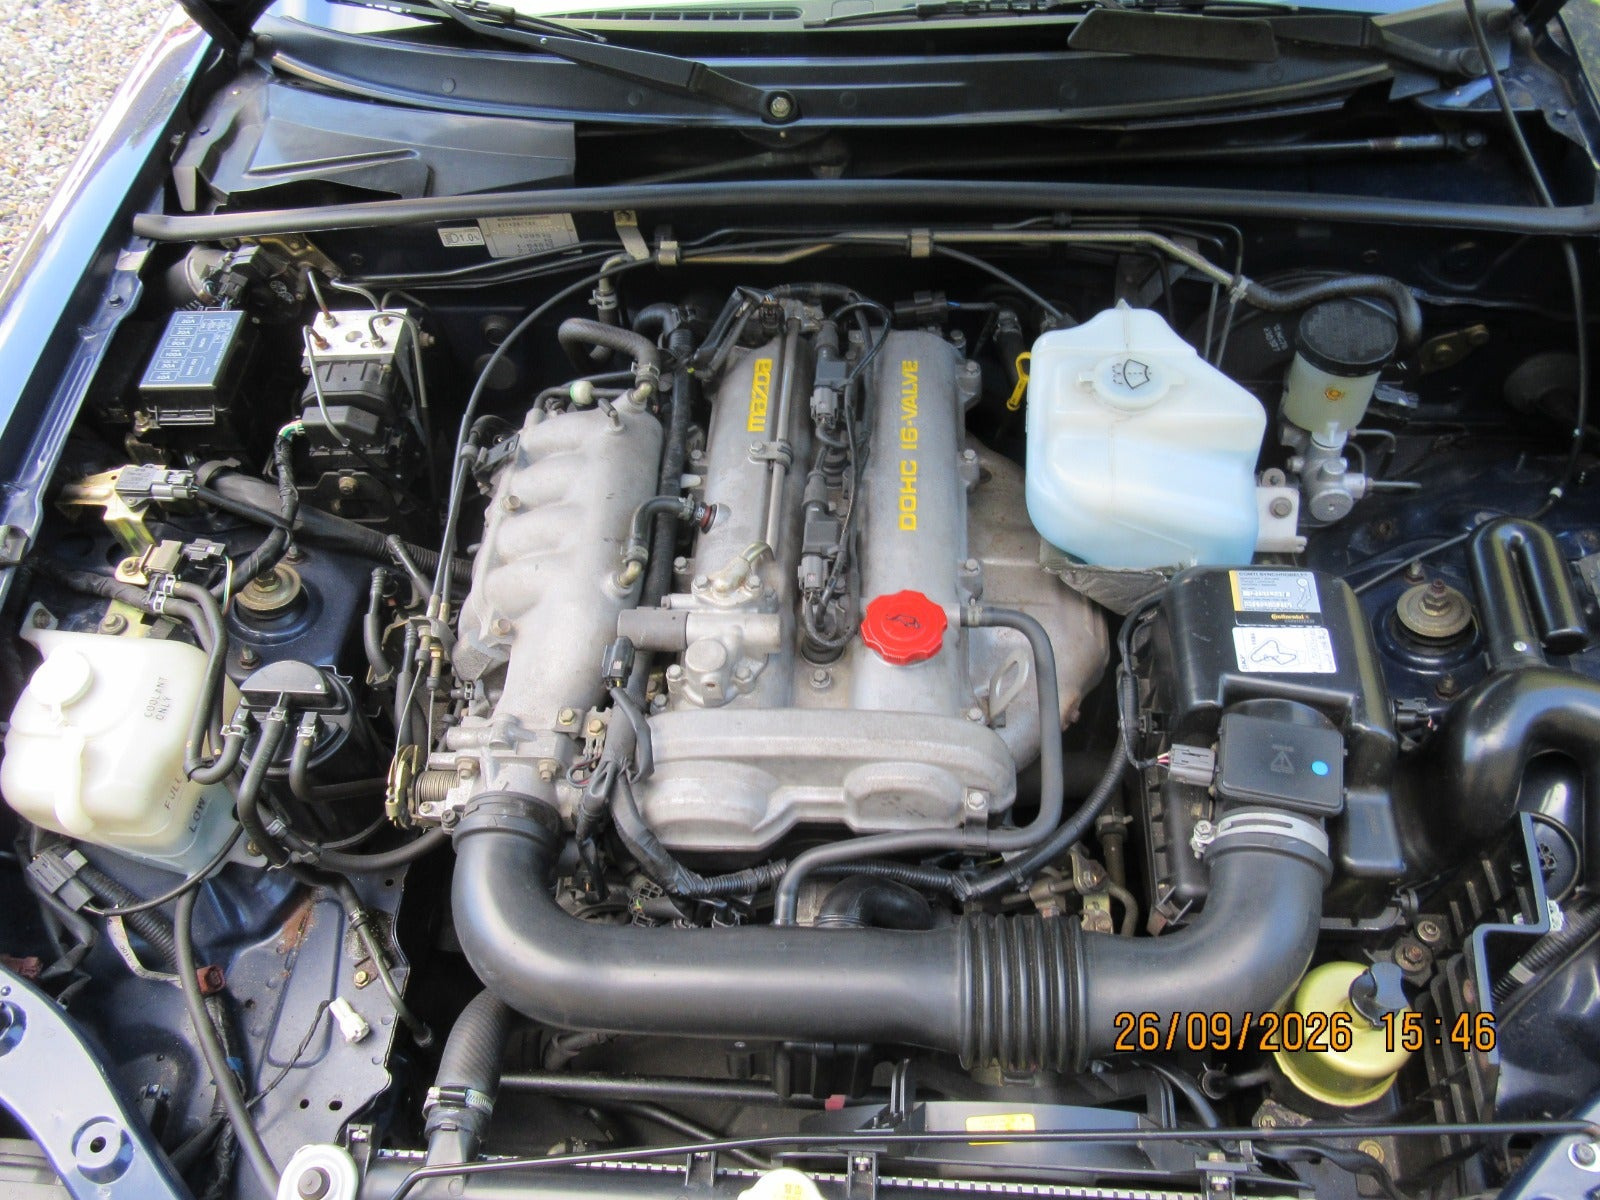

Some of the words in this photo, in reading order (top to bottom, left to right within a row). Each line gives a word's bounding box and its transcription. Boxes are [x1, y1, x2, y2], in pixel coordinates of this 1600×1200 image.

[900, 360, 920, 450] 16-VALVE
[898, 459, 918, 531] DOHC
[143, 676, 168, 718] COOLANT
[156, 695, 173, 721] ONLY
[164, 777, 183, 811] FULL
[188, 797, 207, 834] LOW
